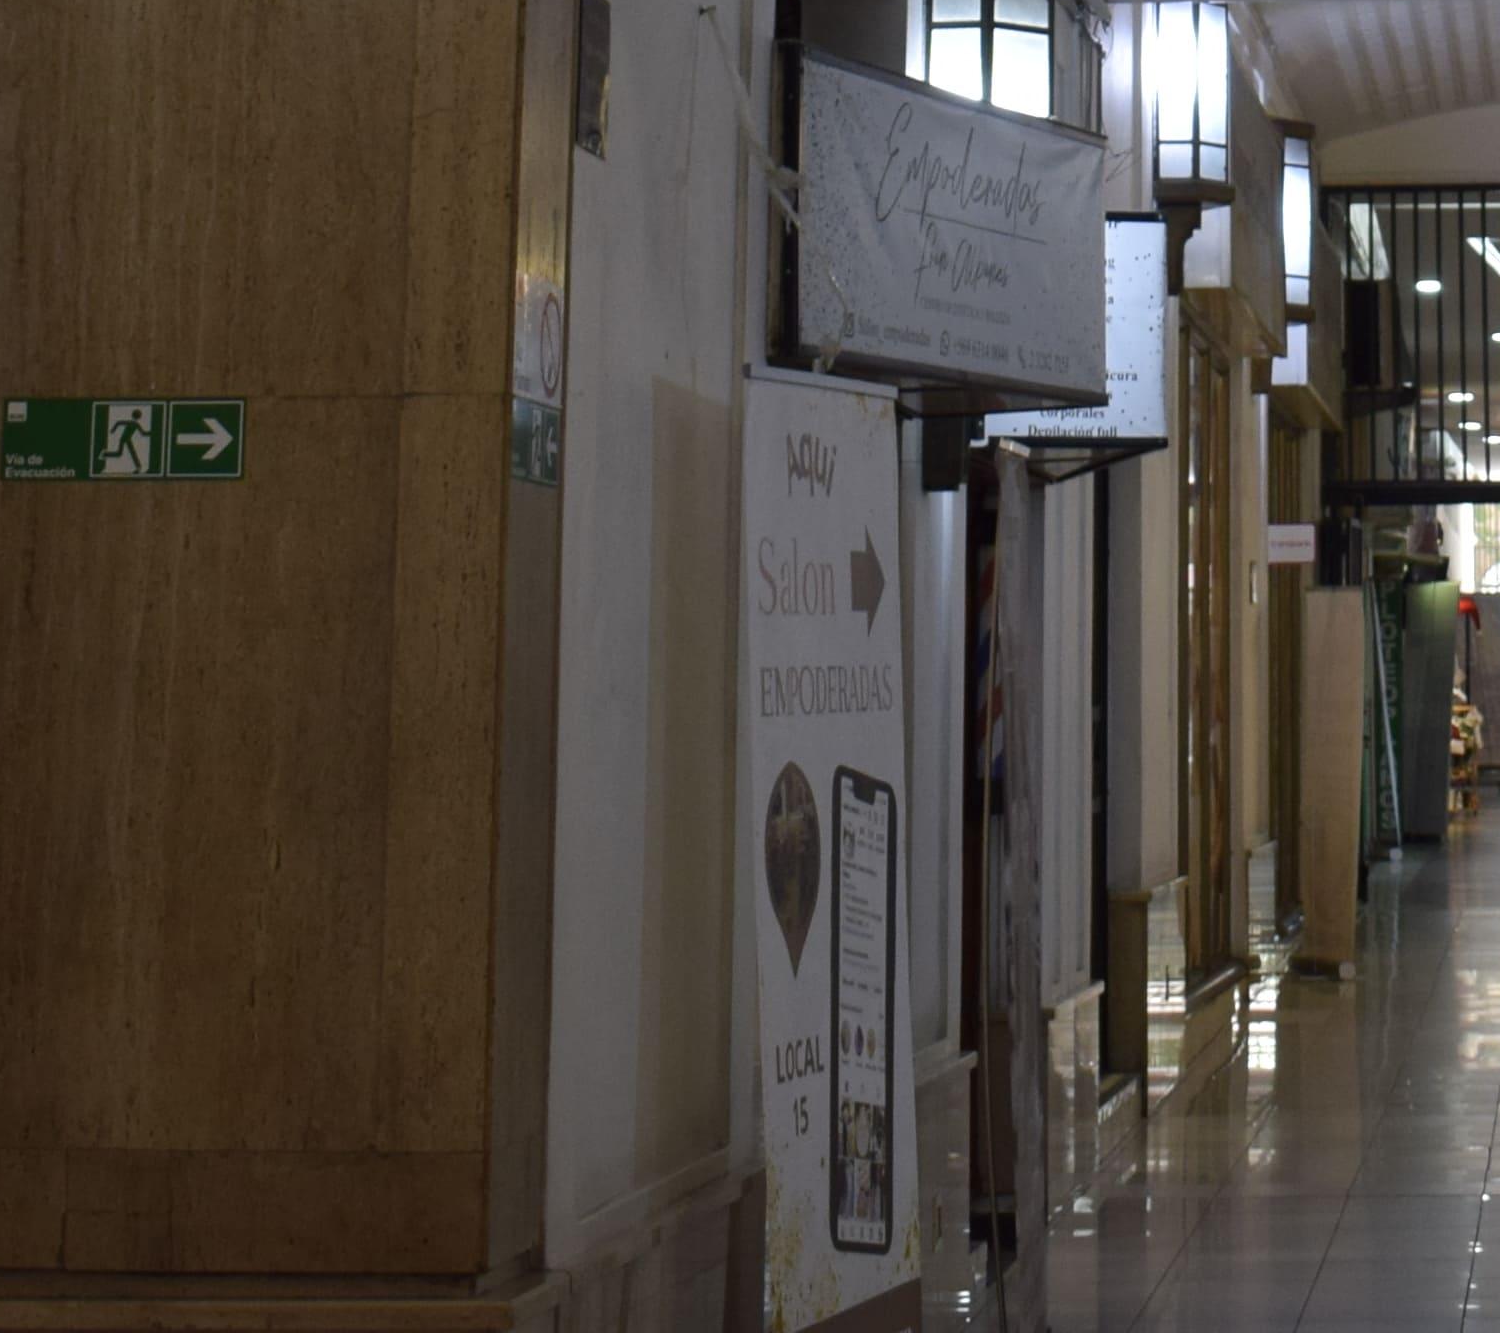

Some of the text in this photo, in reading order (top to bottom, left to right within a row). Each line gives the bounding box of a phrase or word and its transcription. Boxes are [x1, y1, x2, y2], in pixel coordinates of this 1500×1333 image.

[5, 466, 76, 478] Evacuación
[28, 453, 44, 466] de
[758, 536, 836, 615] Salon
[776, 1035, 825, 1085] LOCAL
[793, 1096, 809, 1137] 15
